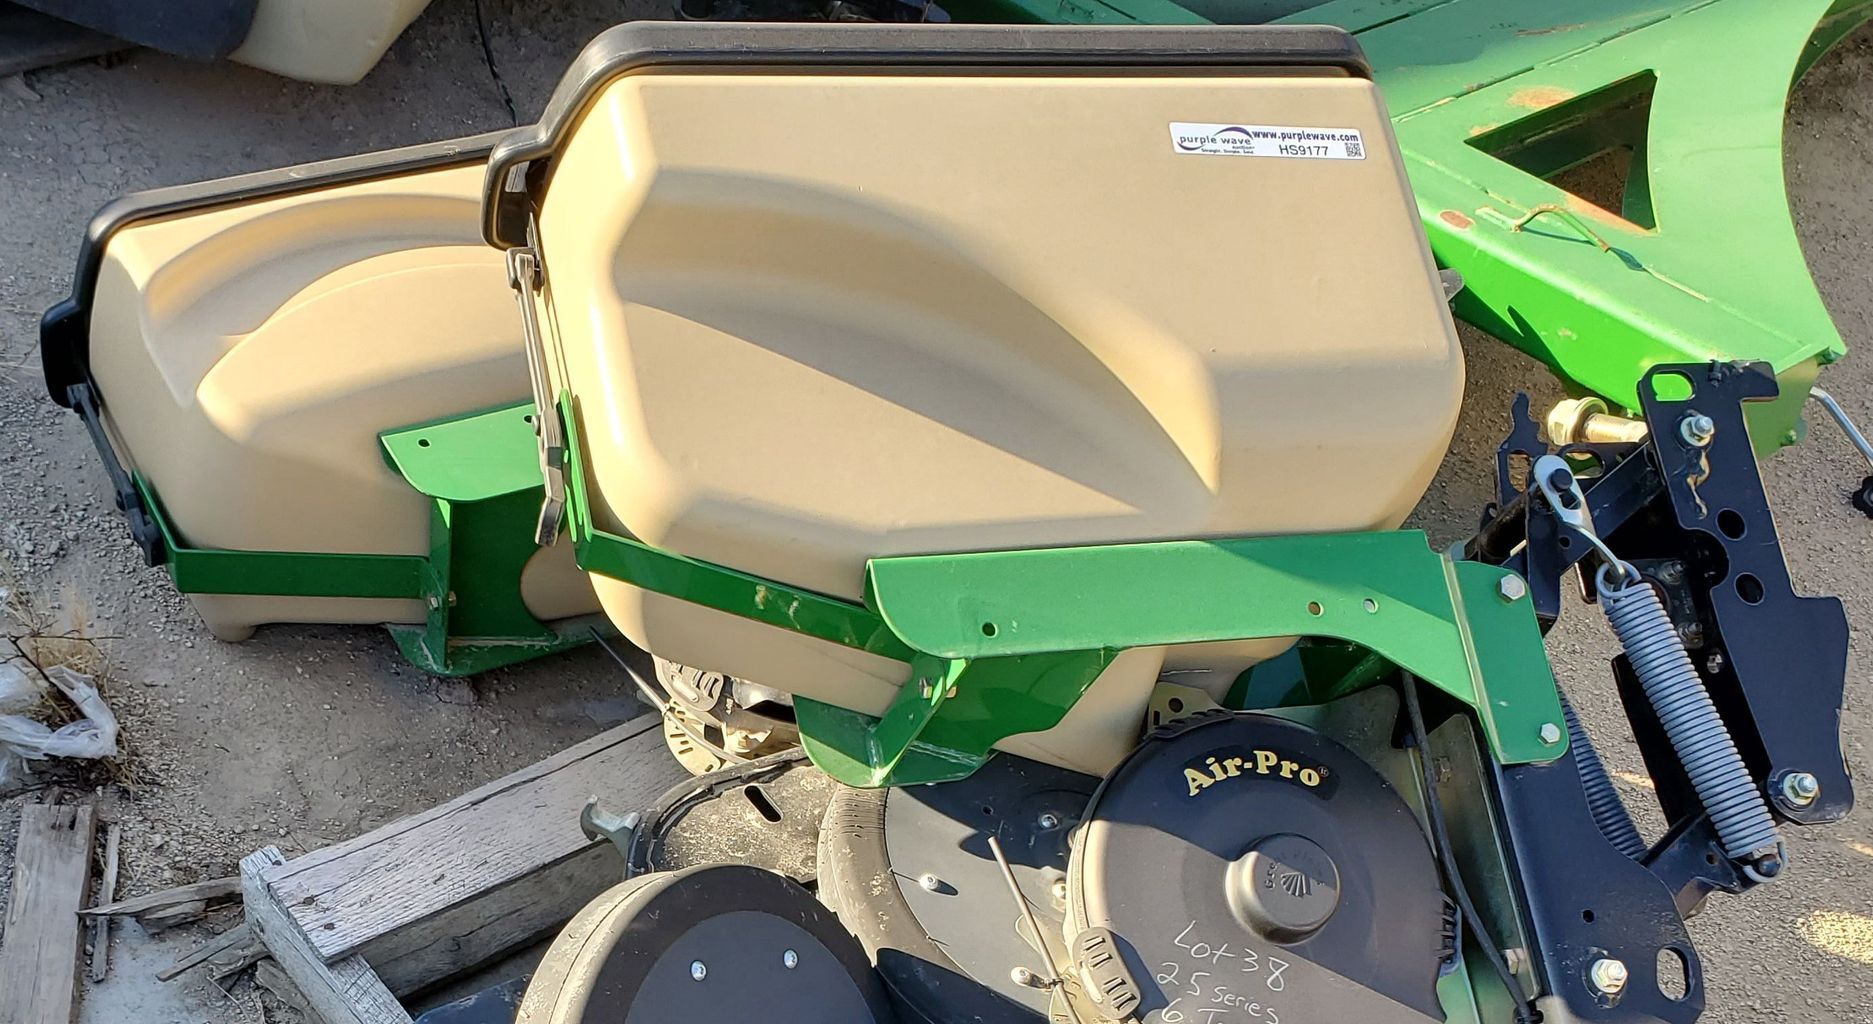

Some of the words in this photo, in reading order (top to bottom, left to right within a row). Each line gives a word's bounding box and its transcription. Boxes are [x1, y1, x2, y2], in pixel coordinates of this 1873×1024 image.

[1179, 135, 1218, 145] purple
[1220, 137, 1251, 145] wave
[1252, 130, 1359, 142] www.purplewave.com
[1279, 144, 1328, 156] HS9177
[1173, 920, 1235, 964] Lot
[1241, 948, 1289, 992] 38
[1160, 997, 1185, 1024] 6
